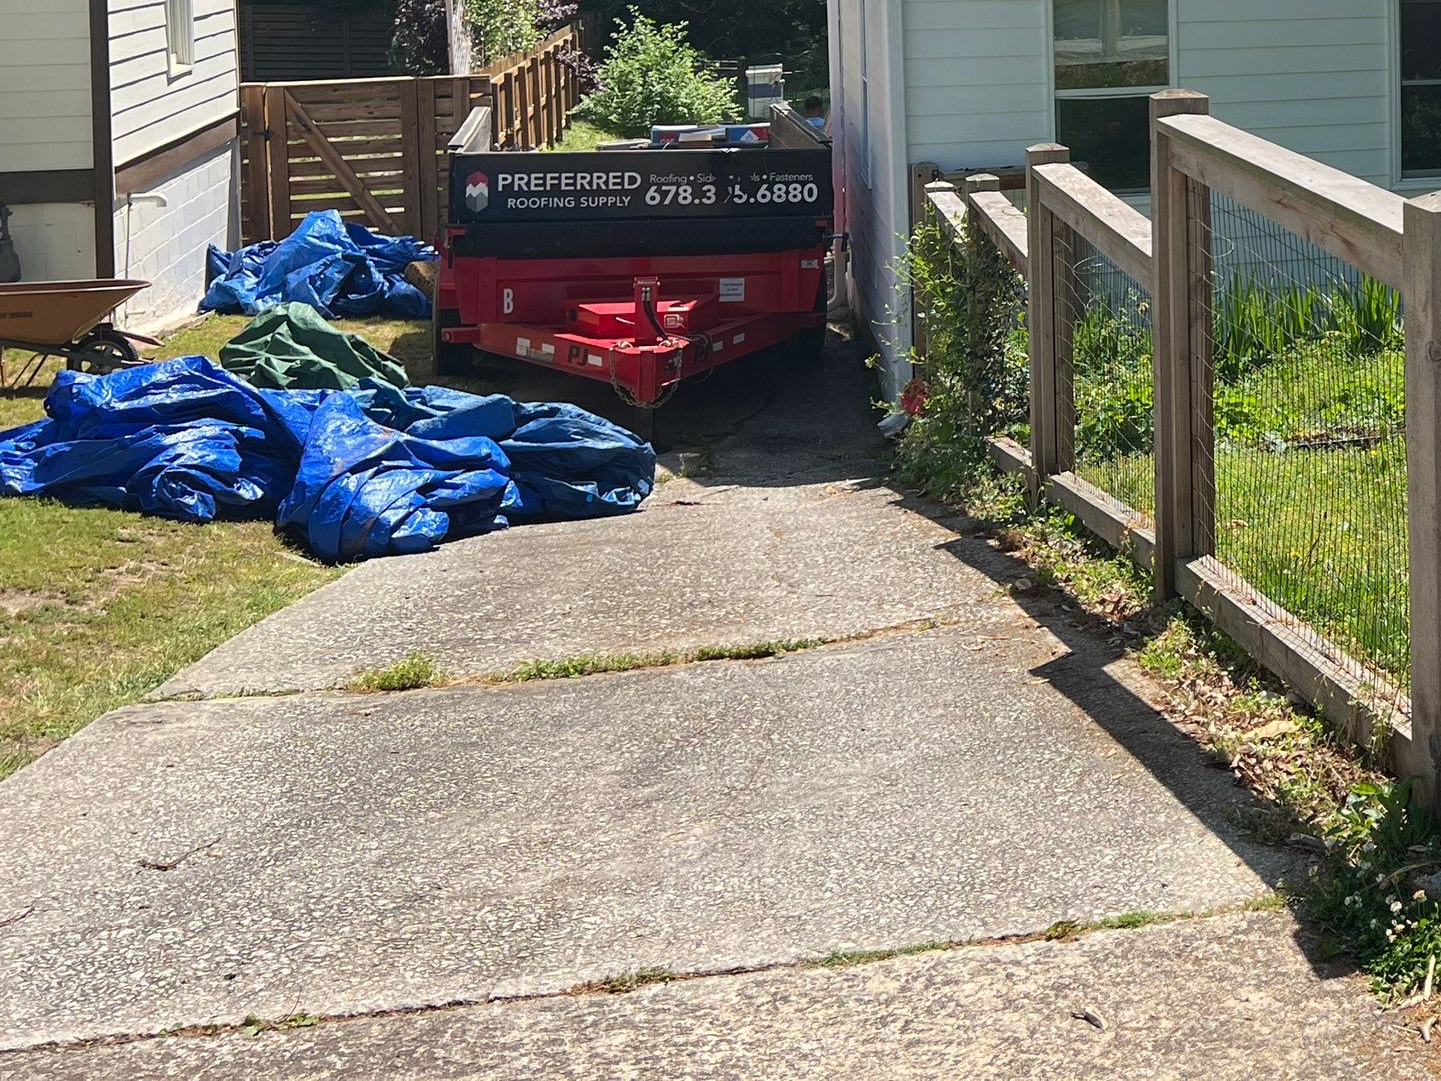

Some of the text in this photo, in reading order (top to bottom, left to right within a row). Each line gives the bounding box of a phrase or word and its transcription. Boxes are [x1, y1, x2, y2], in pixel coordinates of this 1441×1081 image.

[497, 172, 642, 191] PREFERRED
[650, 173, 687, 184] Roofing
[769, 172, 814, 182] Fasteners
[507, 196, 631, 209] ROOFING SUPPLY
[503, 288, 514, 314] B
[567, 344, 589, 367] PJ
